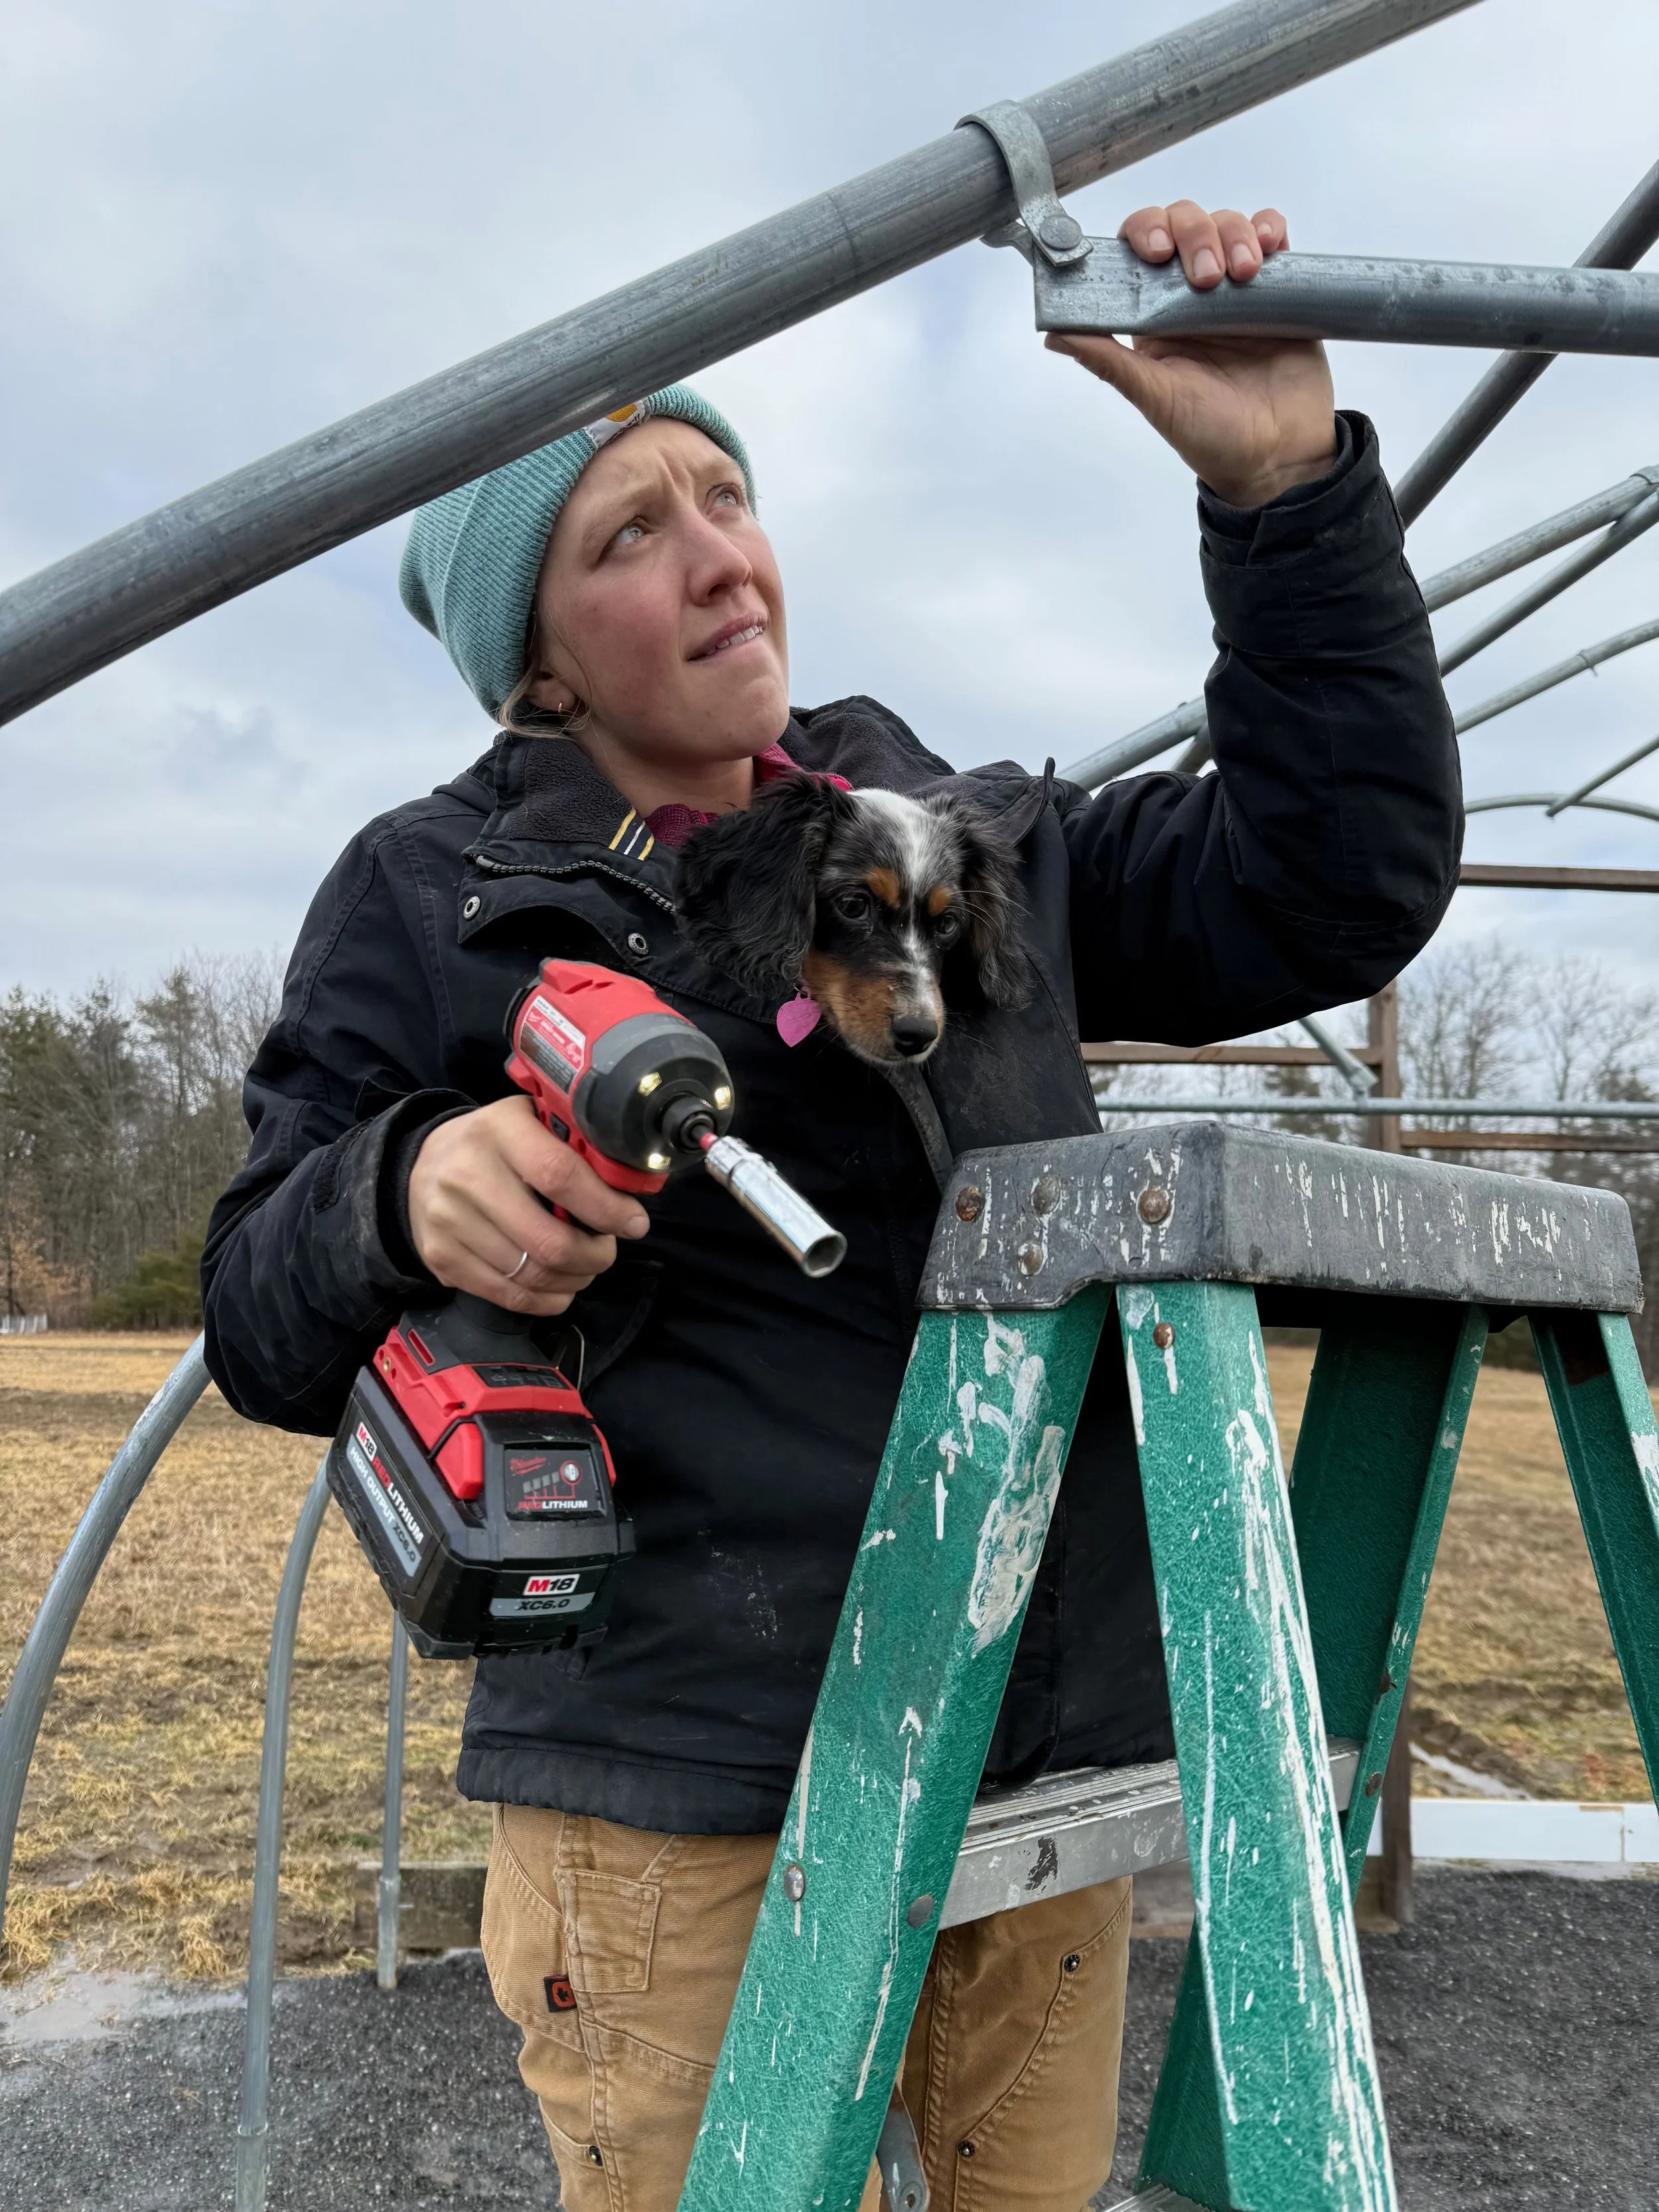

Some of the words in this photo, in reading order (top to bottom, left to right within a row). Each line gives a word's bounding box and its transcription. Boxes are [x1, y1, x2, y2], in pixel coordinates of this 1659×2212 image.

[358, 1426, 375, 1454] M18
[350, 1446, 368, 1479] HIGH
[366, 1476, 395, 1523] OUTPUT
[393, 1522, 416, 1562] XC6.0
[528, 1578, 575, 1592] M18
[516, 1599, 570, 1611] XC6.0
